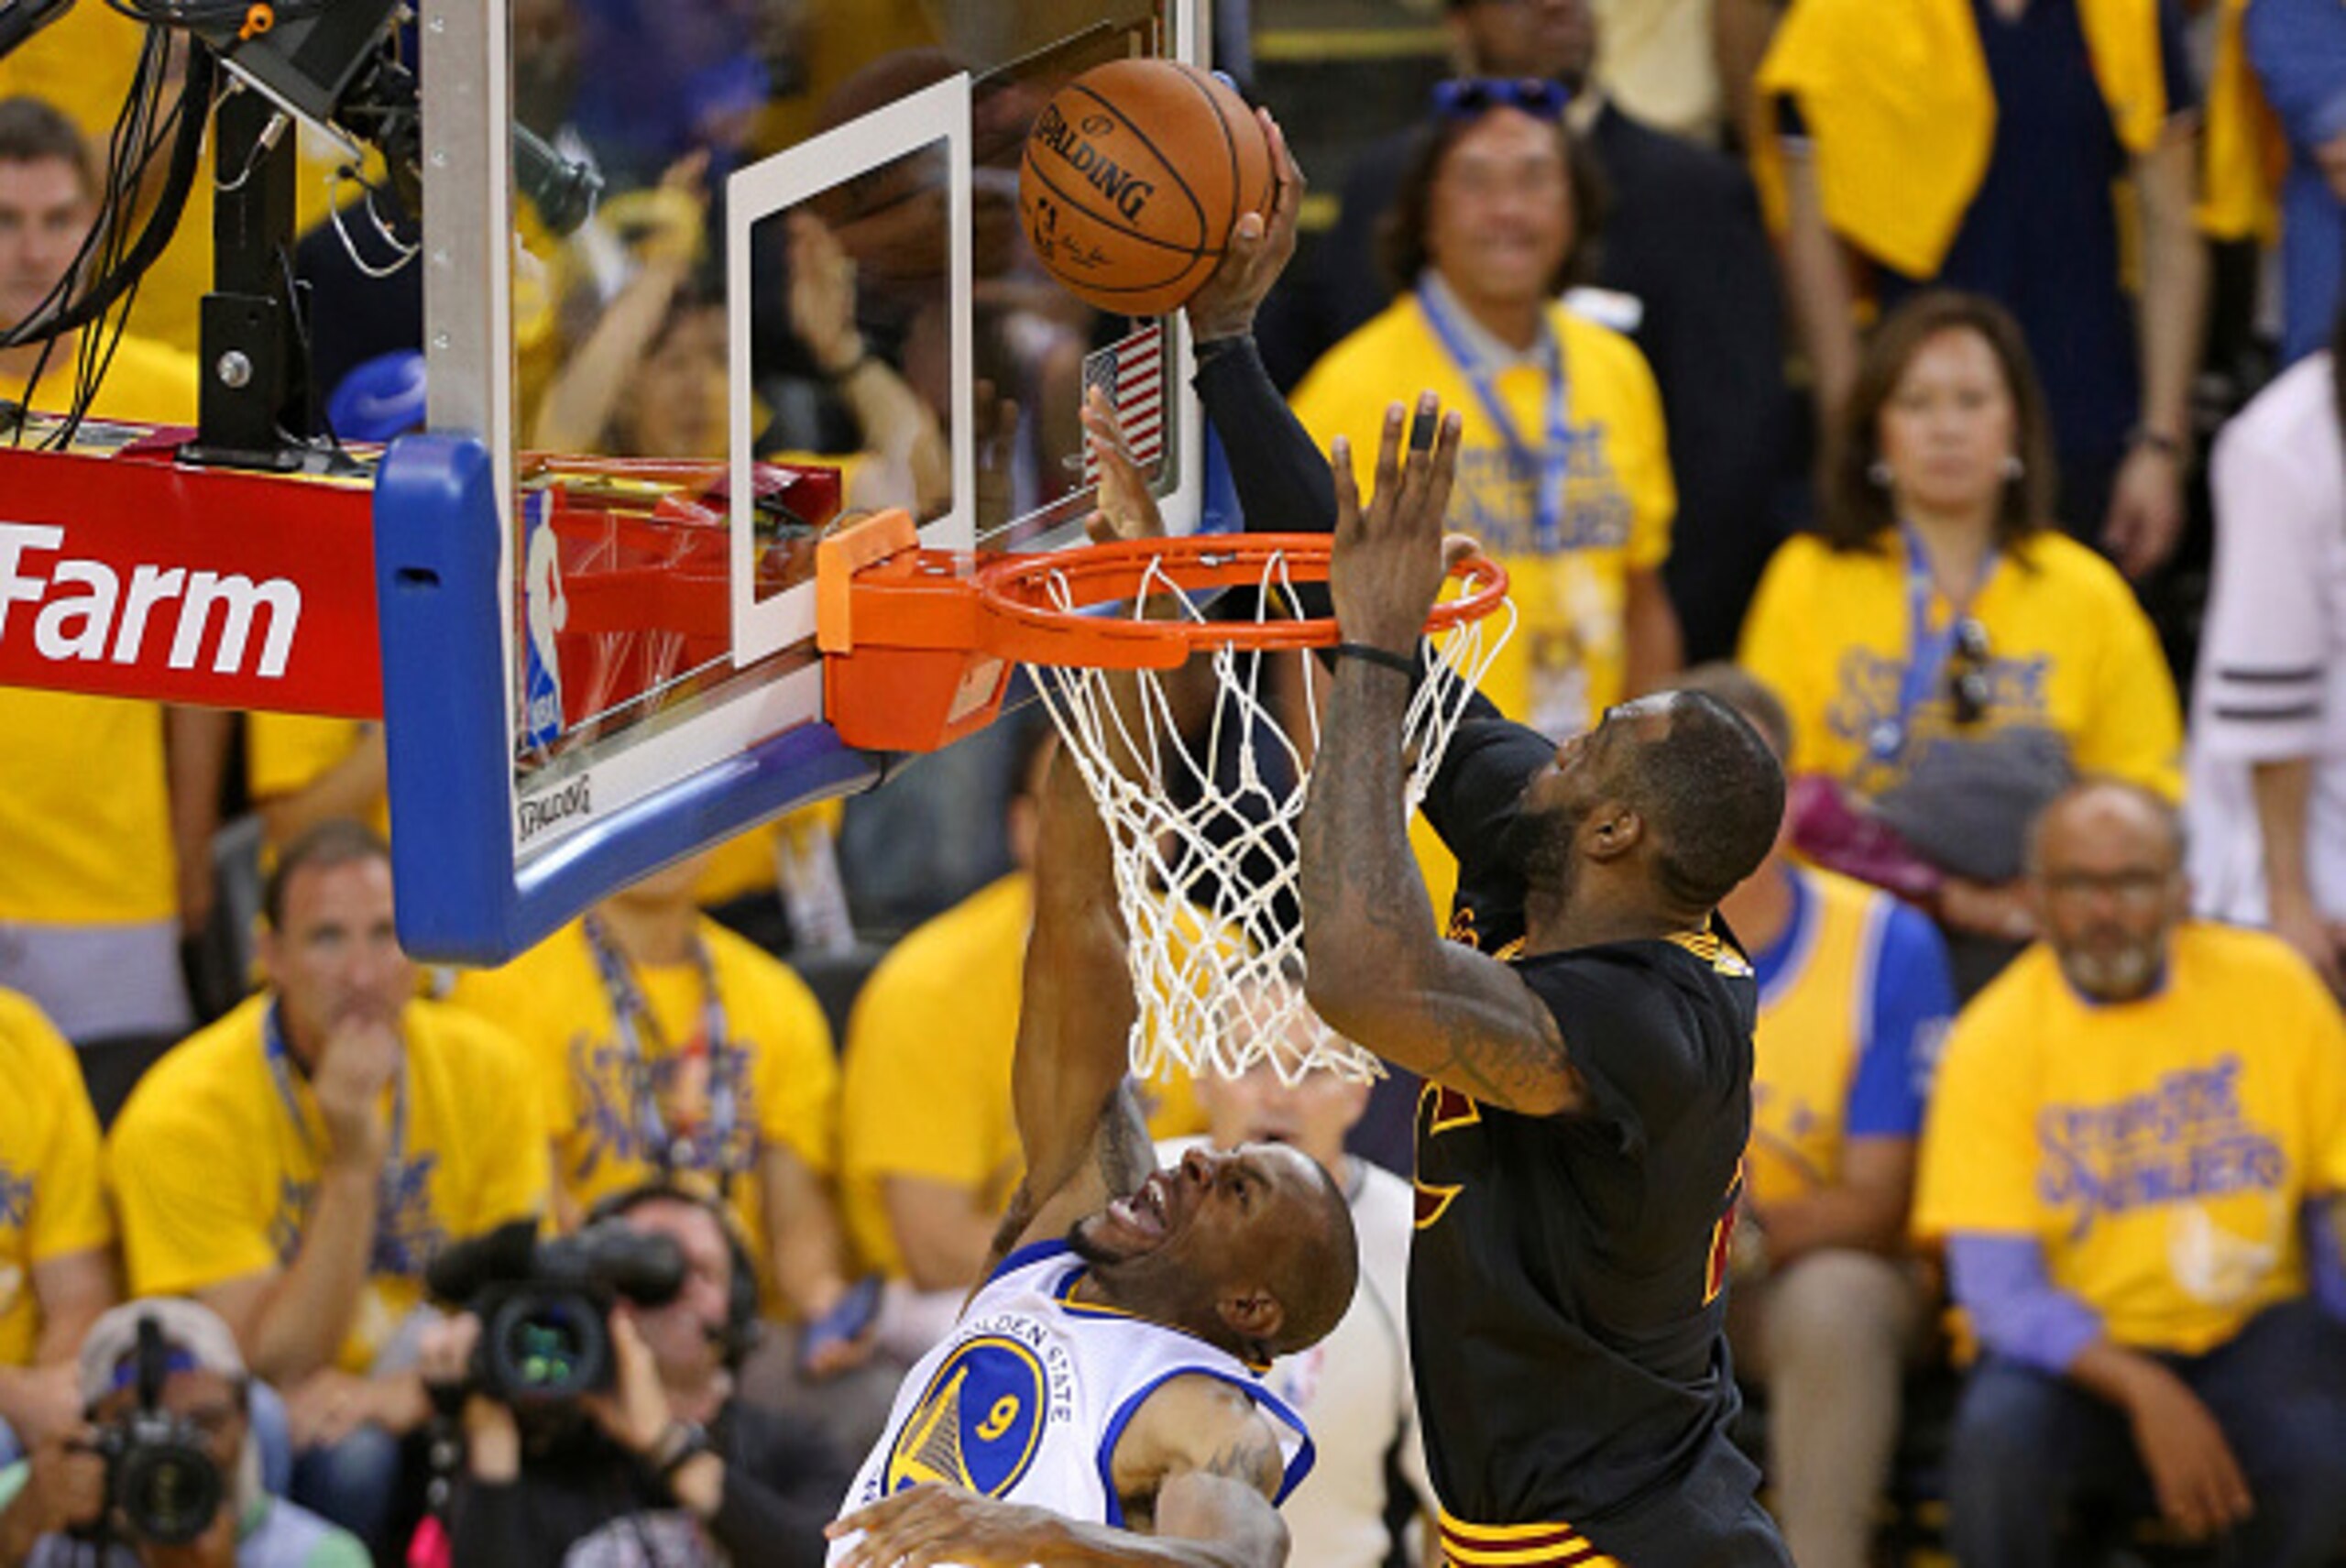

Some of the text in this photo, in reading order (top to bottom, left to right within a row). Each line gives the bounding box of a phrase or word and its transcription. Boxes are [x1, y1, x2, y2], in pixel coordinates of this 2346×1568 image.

[1036, 103, 1155, 222] SPALDING
[0, 521, 302, 678] Farm
[520, 773, 591, 843] SPALDING
[975, 1394, 1021, 1442] 9
[1048, 1345, 1072, 1423] STATE
